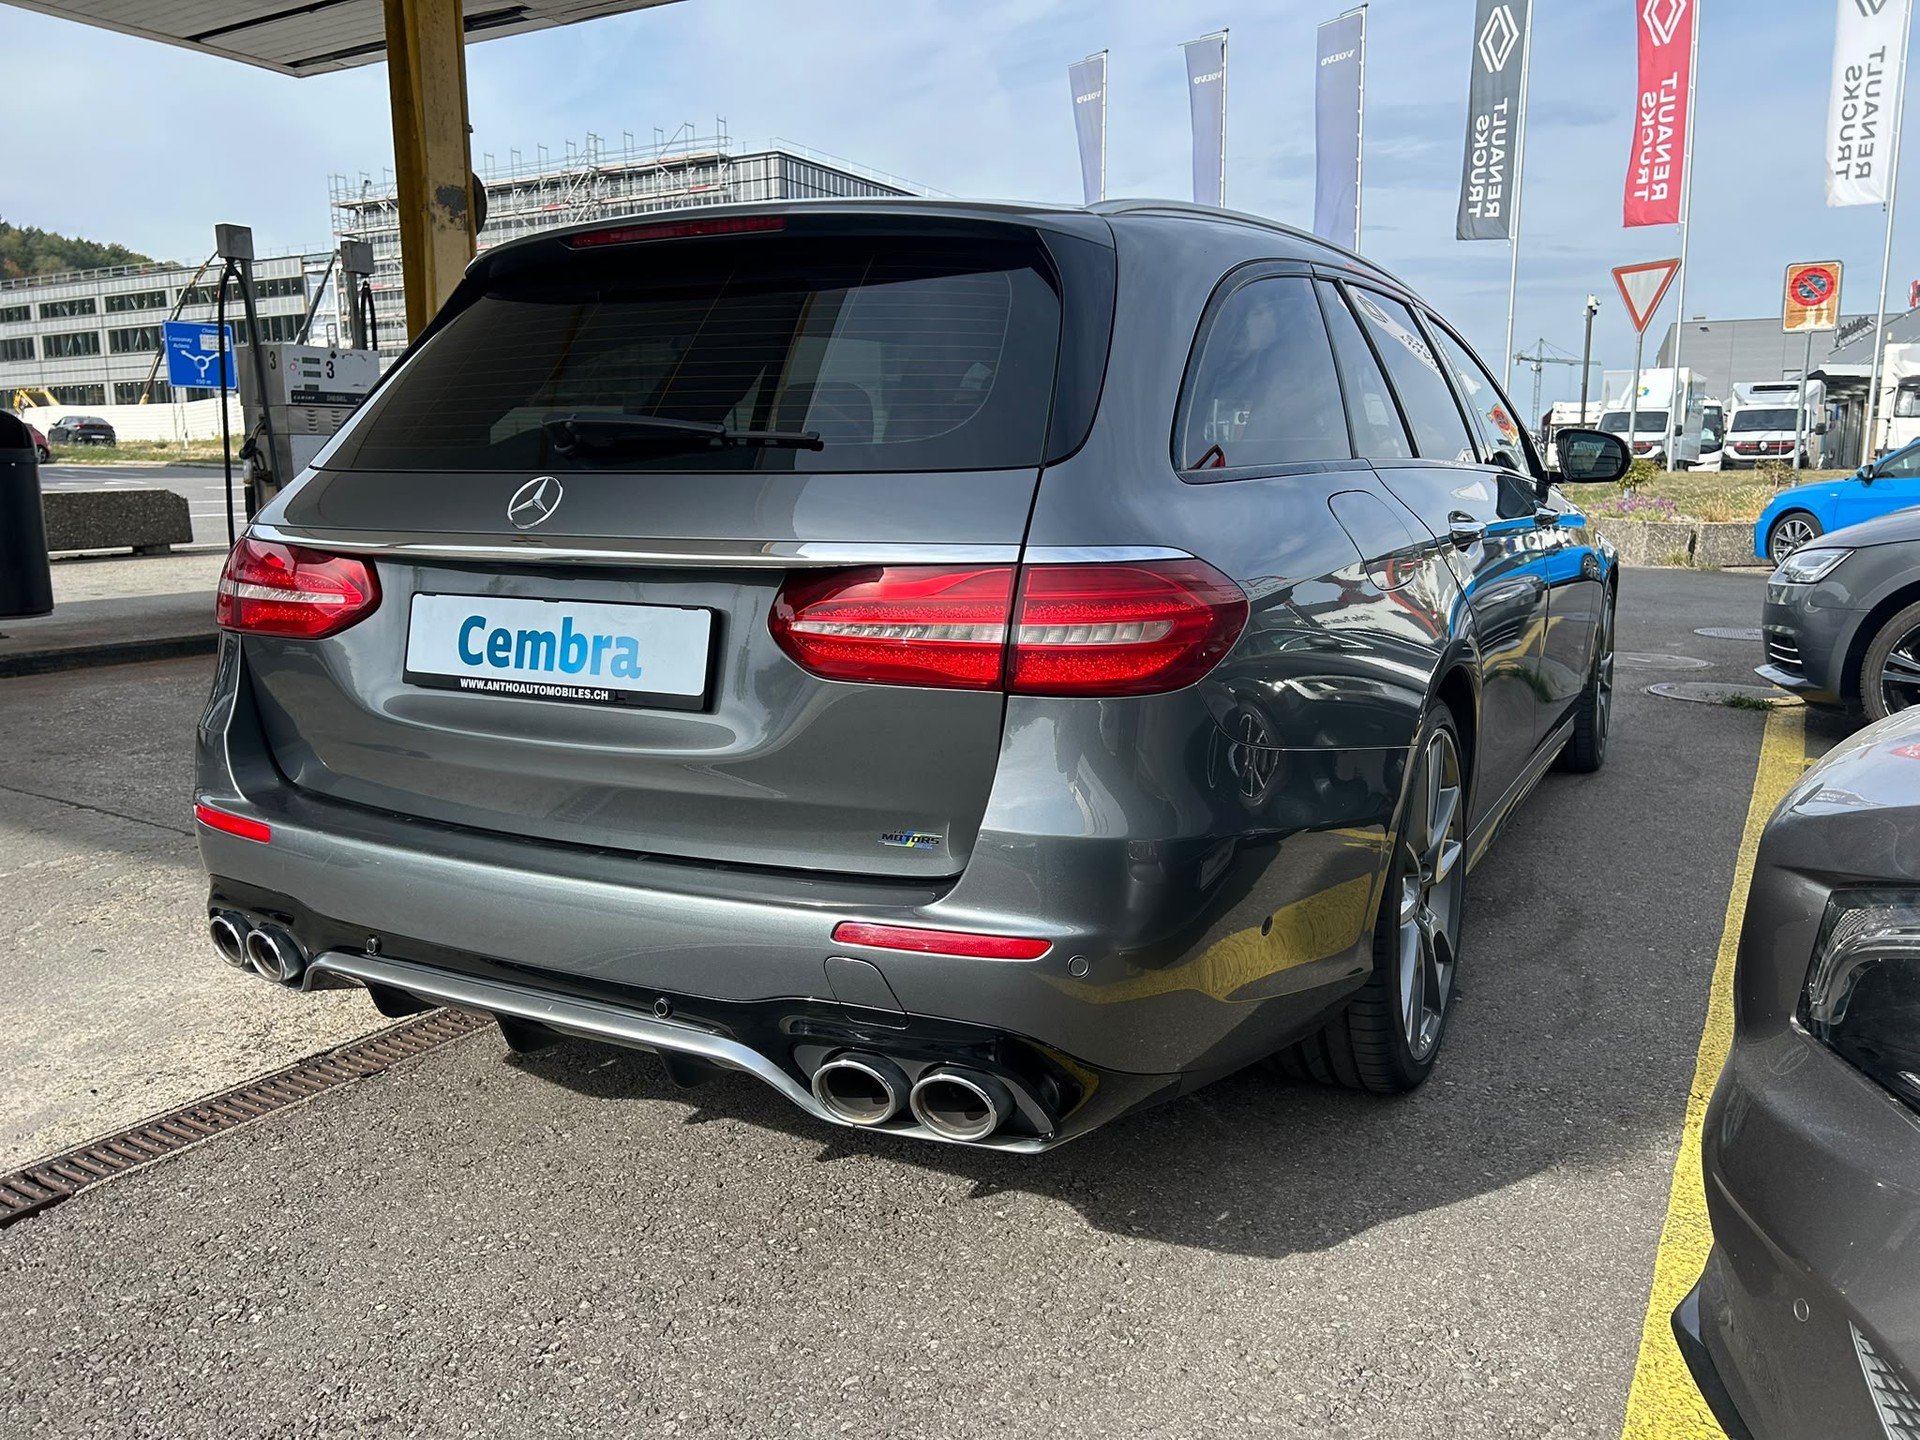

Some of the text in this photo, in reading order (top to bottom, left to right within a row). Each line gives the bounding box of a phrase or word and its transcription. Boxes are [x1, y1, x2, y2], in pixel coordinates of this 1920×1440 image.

[269, 351, 277, 370] 3
[326, 361, 335, 379] 3
[458, 615, 642, 679] Cembra
[460, 678, 609, 700] WWW.ANTHOAUTOMOBILES.CH
[881, 832, 940, 845] MOTORS
